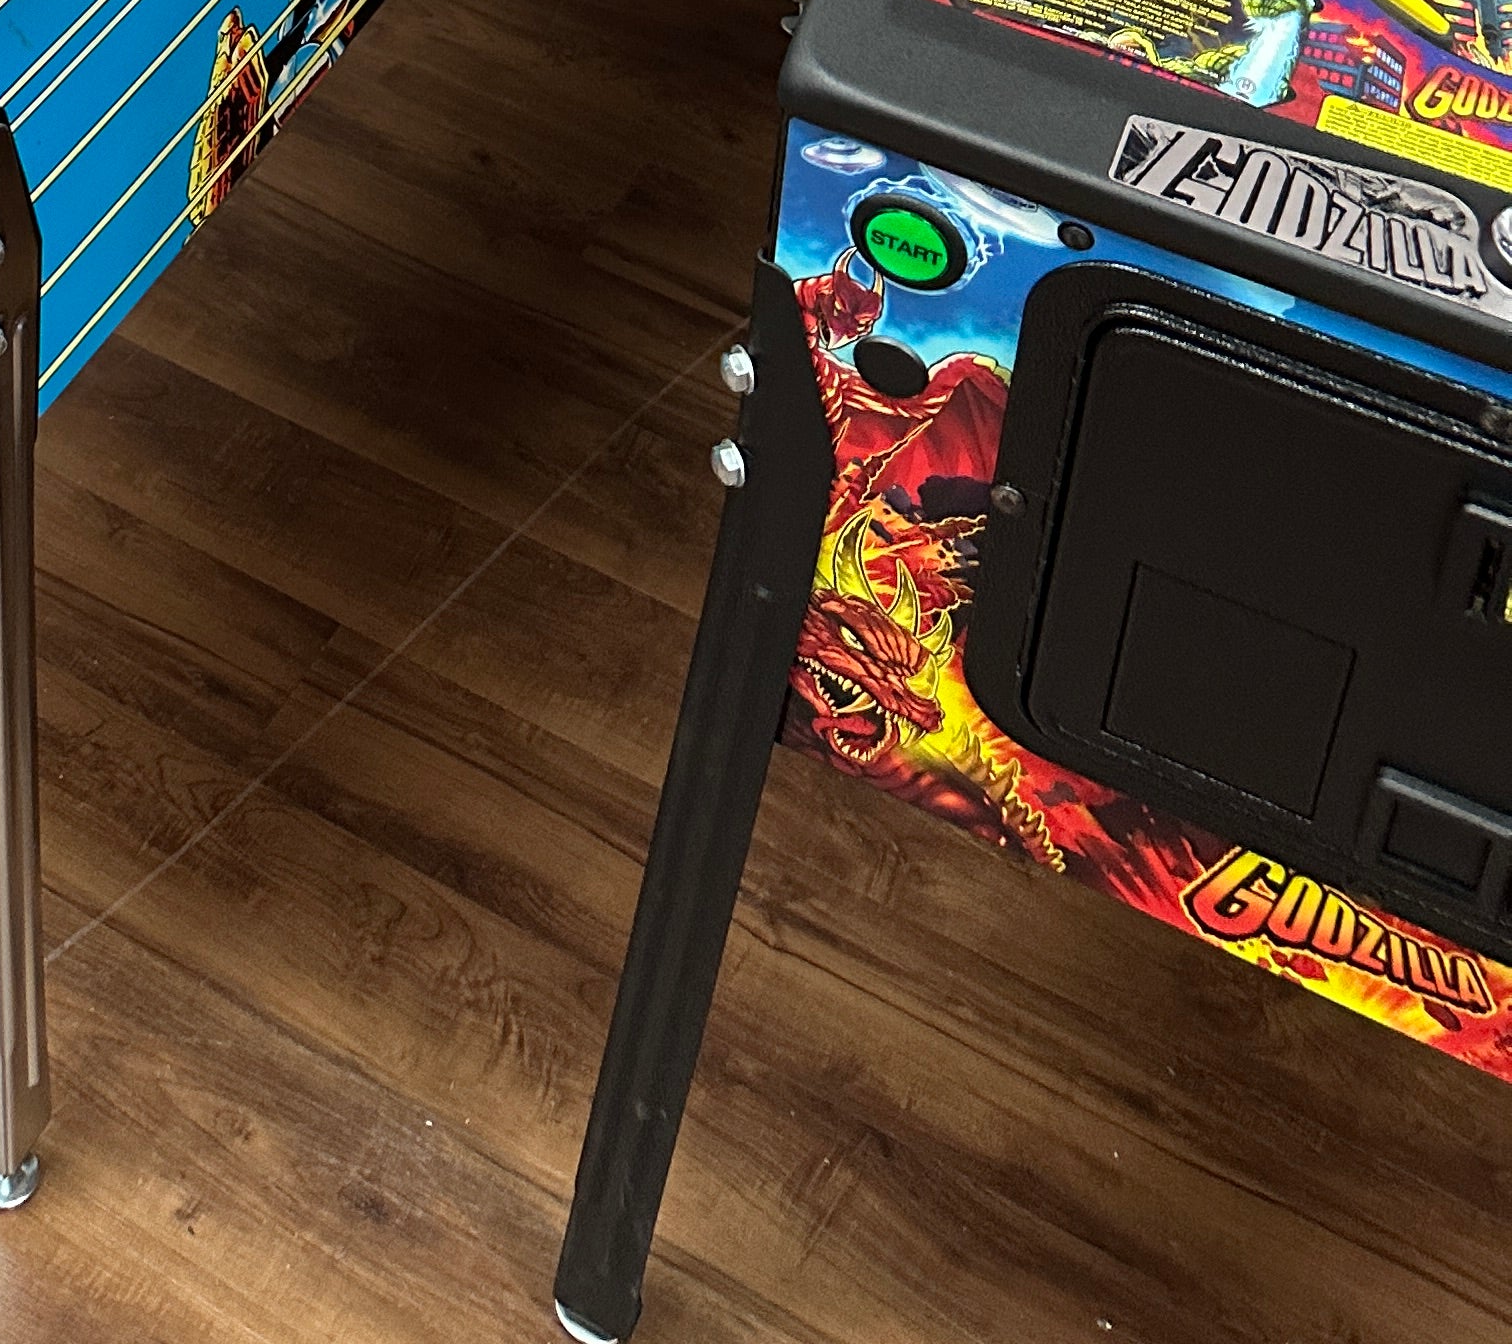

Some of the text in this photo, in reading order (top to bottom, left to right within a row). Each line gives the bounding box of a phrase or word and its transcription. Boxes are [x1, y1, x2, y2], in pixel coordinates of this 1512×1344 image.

[870, 229, 943, 266] START
[1133, 129, 1489, 296] GODZILLA
[1185, 849, 1492, 1014] GODZILLA
